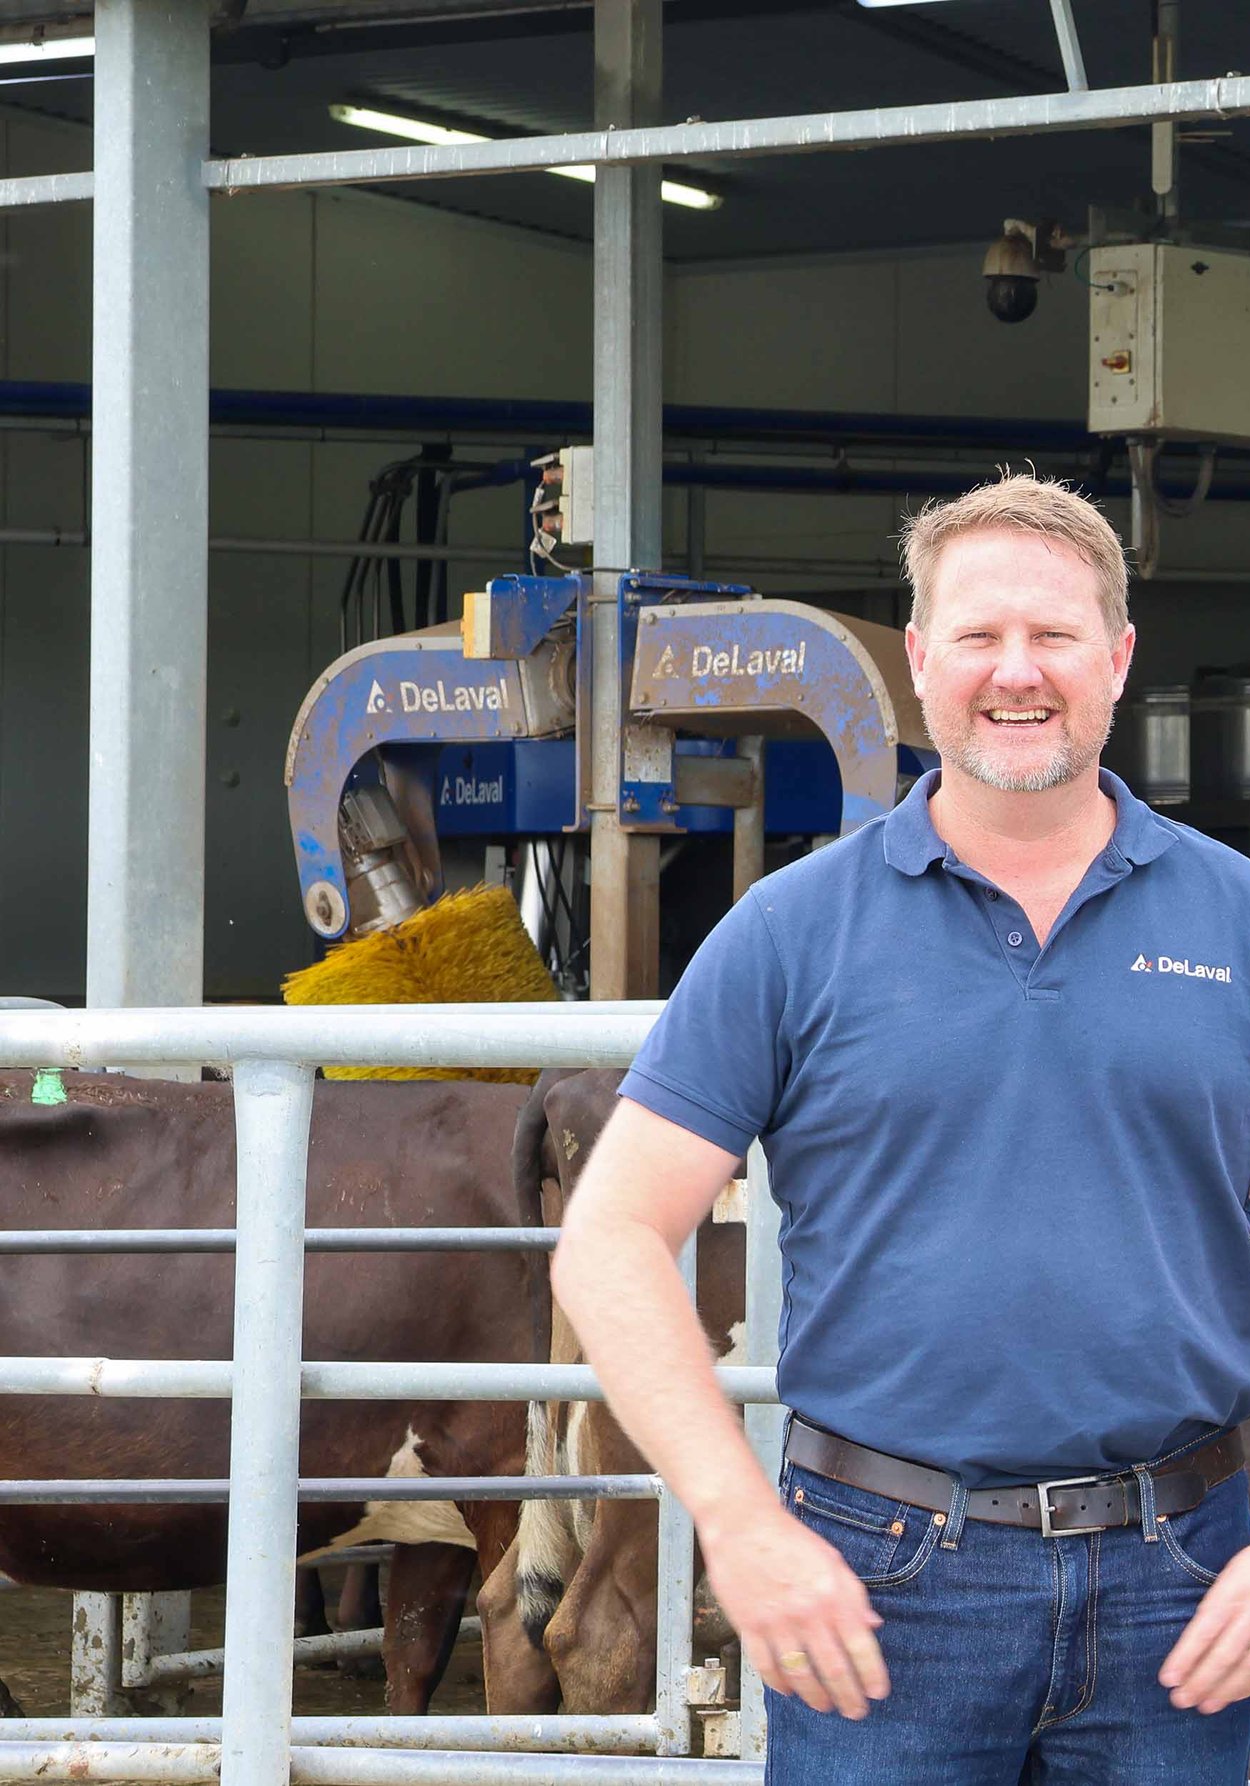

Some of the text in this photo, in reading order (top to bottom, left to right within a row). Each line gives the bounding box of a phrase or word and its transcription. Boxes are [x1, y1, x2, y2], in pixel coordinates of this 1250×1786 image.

[692, 641, 806, 677] DeLaval
[400, 678, 509, 712] DeLaval
[456, 775, 503, 804] DeLaval
[1158, 956, 1231, 983] DeLaval
